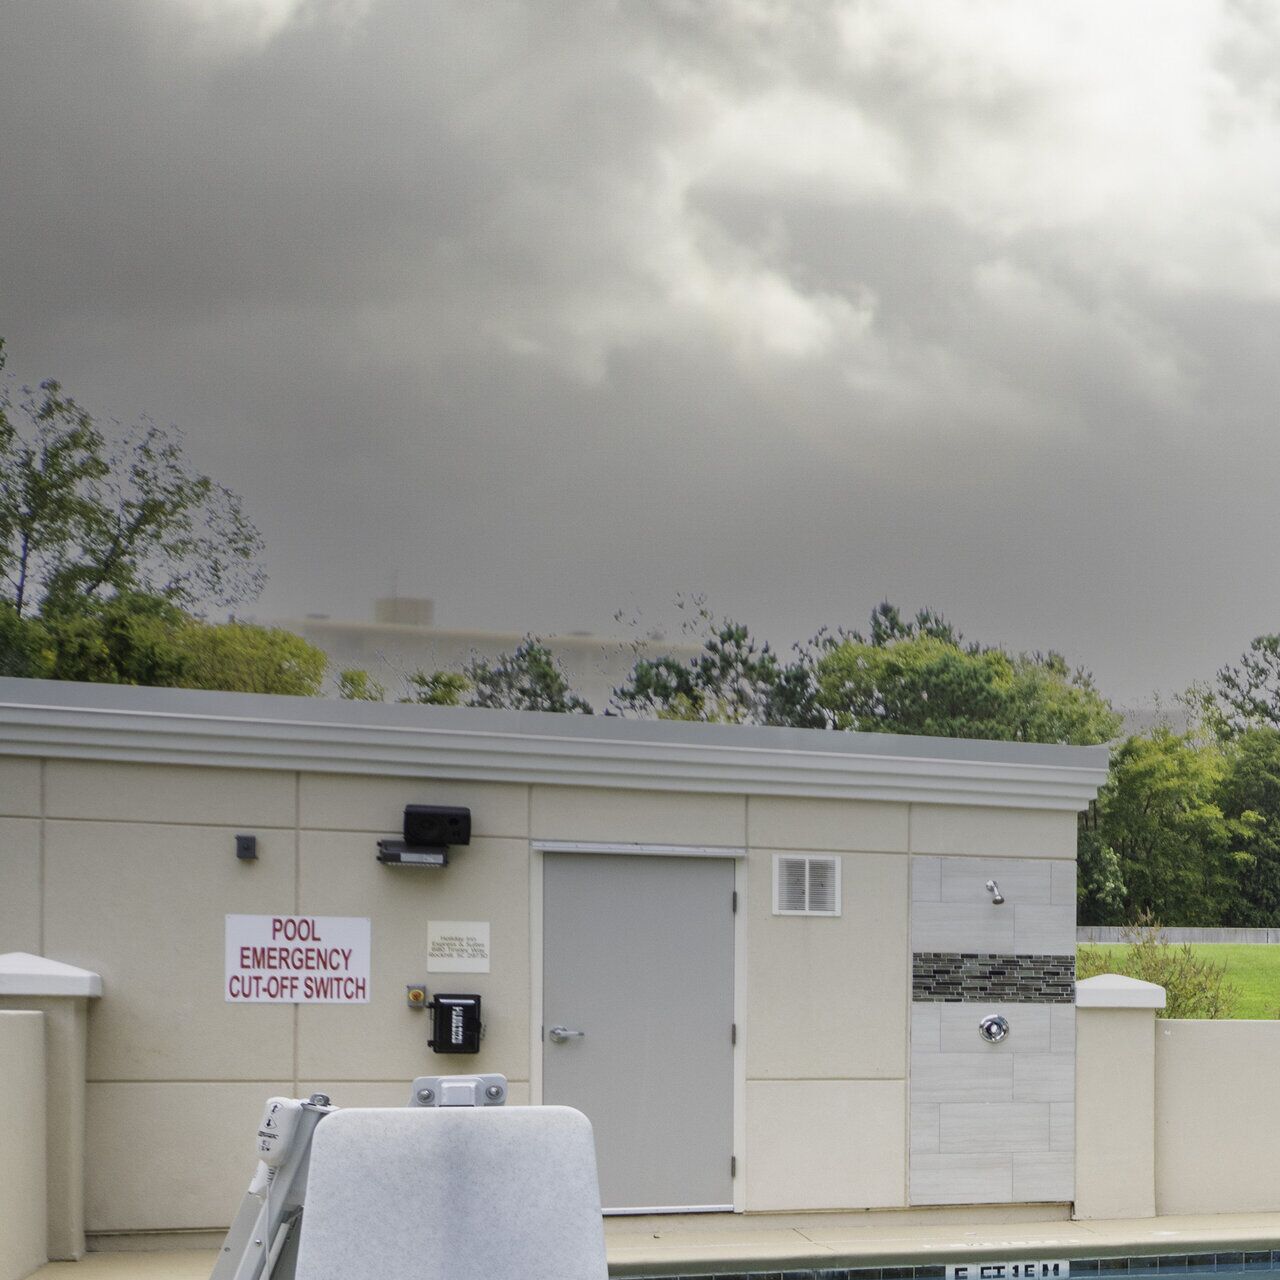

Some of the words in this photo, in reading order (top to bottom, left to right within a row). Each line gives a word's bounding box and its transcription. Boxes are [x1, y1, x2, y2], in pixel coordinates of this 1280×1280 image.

[271, 918, 321, 941] POOL
[240, 946, 352, 971] EMERGENCY
[229, 975, 299, 998] CUT-OFF
[303, 976, 366, 999] SWITCH
